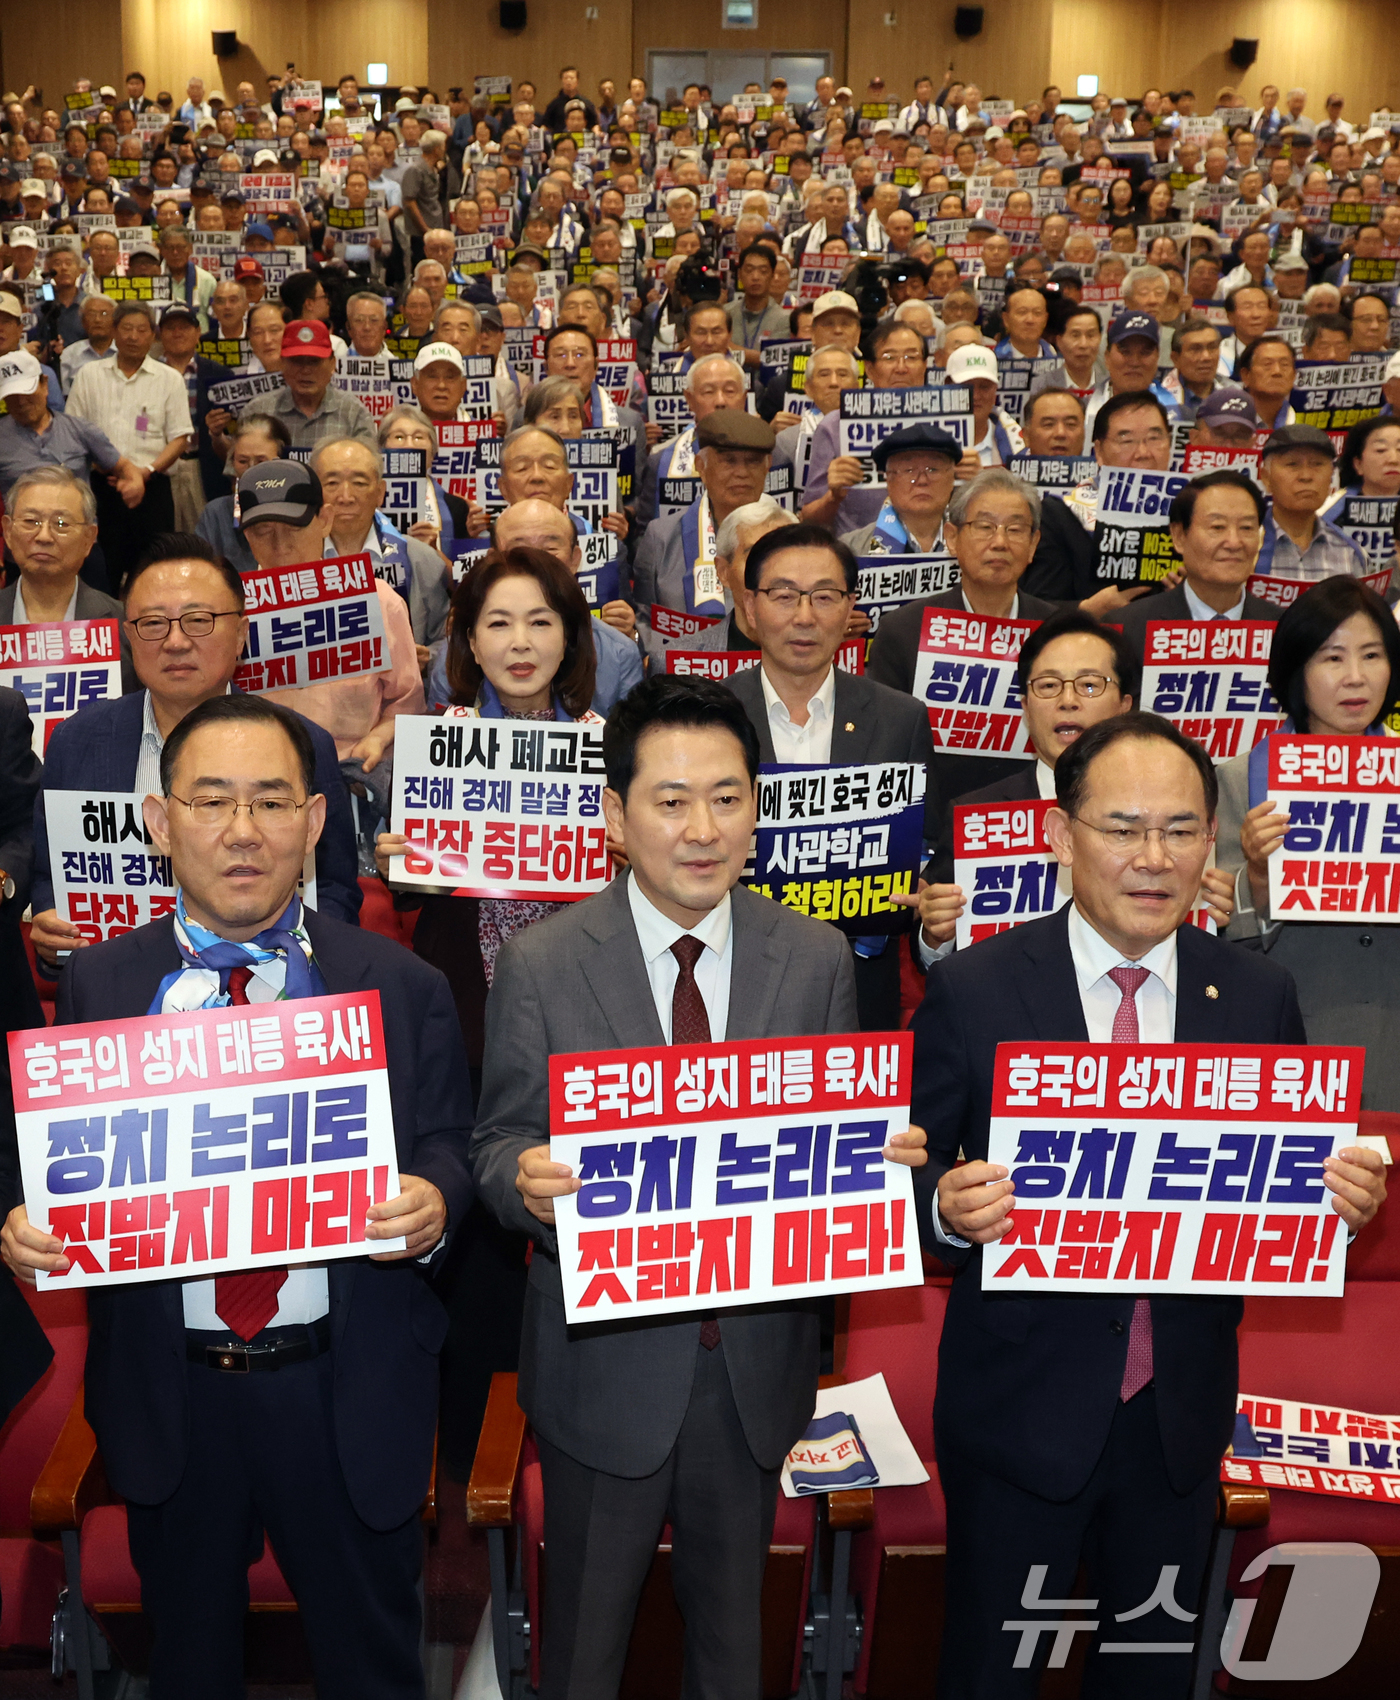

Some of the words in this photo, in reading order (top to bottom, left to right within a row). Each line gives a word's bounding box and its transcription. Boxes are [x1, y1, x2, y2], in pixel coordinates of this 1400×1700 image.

[347, 360, 386, 377] 폐교는
[431, 347, 452, 357] KMA
[611, 342, 633, 359] 육사!
[765, 347, 779, 363] 정치
[966, 357, 987, 367] KMA
[212, 387, 227, 401] 정치
[229, 382, 253, 400] 논리에
[651, 375, 674, 393] 역사를
[1316, 368, 1340, 387] 논리에
[844, 392, 871, 416] 역사를
[873, 392, 902, 416] 지우는
[904, 390, 940, 414] 사관학교
[1304, 391, 1329, 410] 3군
[1329, 387, 1383, 408] 사관학교
[442, 425, 464, 444] 태릉
[467, 424, 493, 442] 육사!
[255, 477, 287, 490] KMA
[664, 481, 693, 502] 역사를
[1040, 461, 1069, 483] 지우는
[1350, 502, 1379, 523] 역사를
[585, 534, 610, 565] 성지
[279, 569, 320, 602] 태릉
[322, 560, 369, 594] 육사!
[880, 568, 917, 598] 논리에
[921, 565, 945, 593] 찢긴
[26, 629, 64, 661] 태릉
[68, 626, 113, 659] 육사!
[271, 600, 370, 654] 논리로
[927, 615, 987, 652] 호국의
[1150, 628, 1206, 660] 호국의
[1210, 628, 1248, 659] 성지
[308, 636, 382, 682] 마라!
[12, 668, 109, 713] 논리로
[925, 661, 1000, 706] 정치
[1154, 671, 1221, 713] 정치
[429, 724, 500, 770] 해사
[509, 728, 606, 775] 폐교는
[1278, 743, 1349, 785] 호국의
[404, 777, 456, 810] 진해
[462, 778, 512, 814] 경제
[521, 781, 571, 816] 말살
[788, 776, 826, 819] 찢긴
[831, 772, 870, 812] 호국
[876, 766, 914, 808] 성지
[963, 809, 1034, 850] 호국의
[1283, 800, 1370, 853] 정치
[404, 818, 472, 879] 당장
[766, 824, 891, 875] 사관학교
[62, 851, 114, 884] 진해
[121, 854, 173, 887] 경제
[971, 861, 1059, 916] 정치
[1279, 860, 1400, 913] 짓밟지
[23, 1033, 131, 1099] 호국의
[139, 1024, 208, 1085] 성지
[216, 1015, 285, 1075] 태릉
[293, 1005, 373, 1066] 육사!
[562, 1060, 663, 1123] 호국의
[674, 1054, 739, 1113] 성지
[750, 1048, 814, 1107] 태릉
[824, 1044, 899, 1100] 육사!
[1005, 1054, 1108, 1108] 호국의
[1118, 1056, 1186, 1110] 성지
[1193, 1057, 1261, 1111] 태릉
[1271, 1058, 1350, 1113] 육사!
[46, 1107, 168, 1195] 정치
[191, 1084, 368, 1177] 논리로
[576, 1135, 697, 1218] 정치
[716, 1120, 889, 1206] 논리로
[1009, 1128, 1137, 1199] 정치
[1147, 1132, 1335, 1204] 논리로
[47, 1184, 230, 1278] 짓밟지
[250, 1165, 389, 1255] 마라!
[576, 1215, 752, 1309] 짓밟지
[772, 1198, 906, 1286] 마라!
[993, 1208, 1182, 1281] 짓밟지
[1191, 1212, 1340, 1284] 마라!
[1259, 1464, 1316, 1488] 태릉
[1319, 1470, 1375, 1496] 성지
